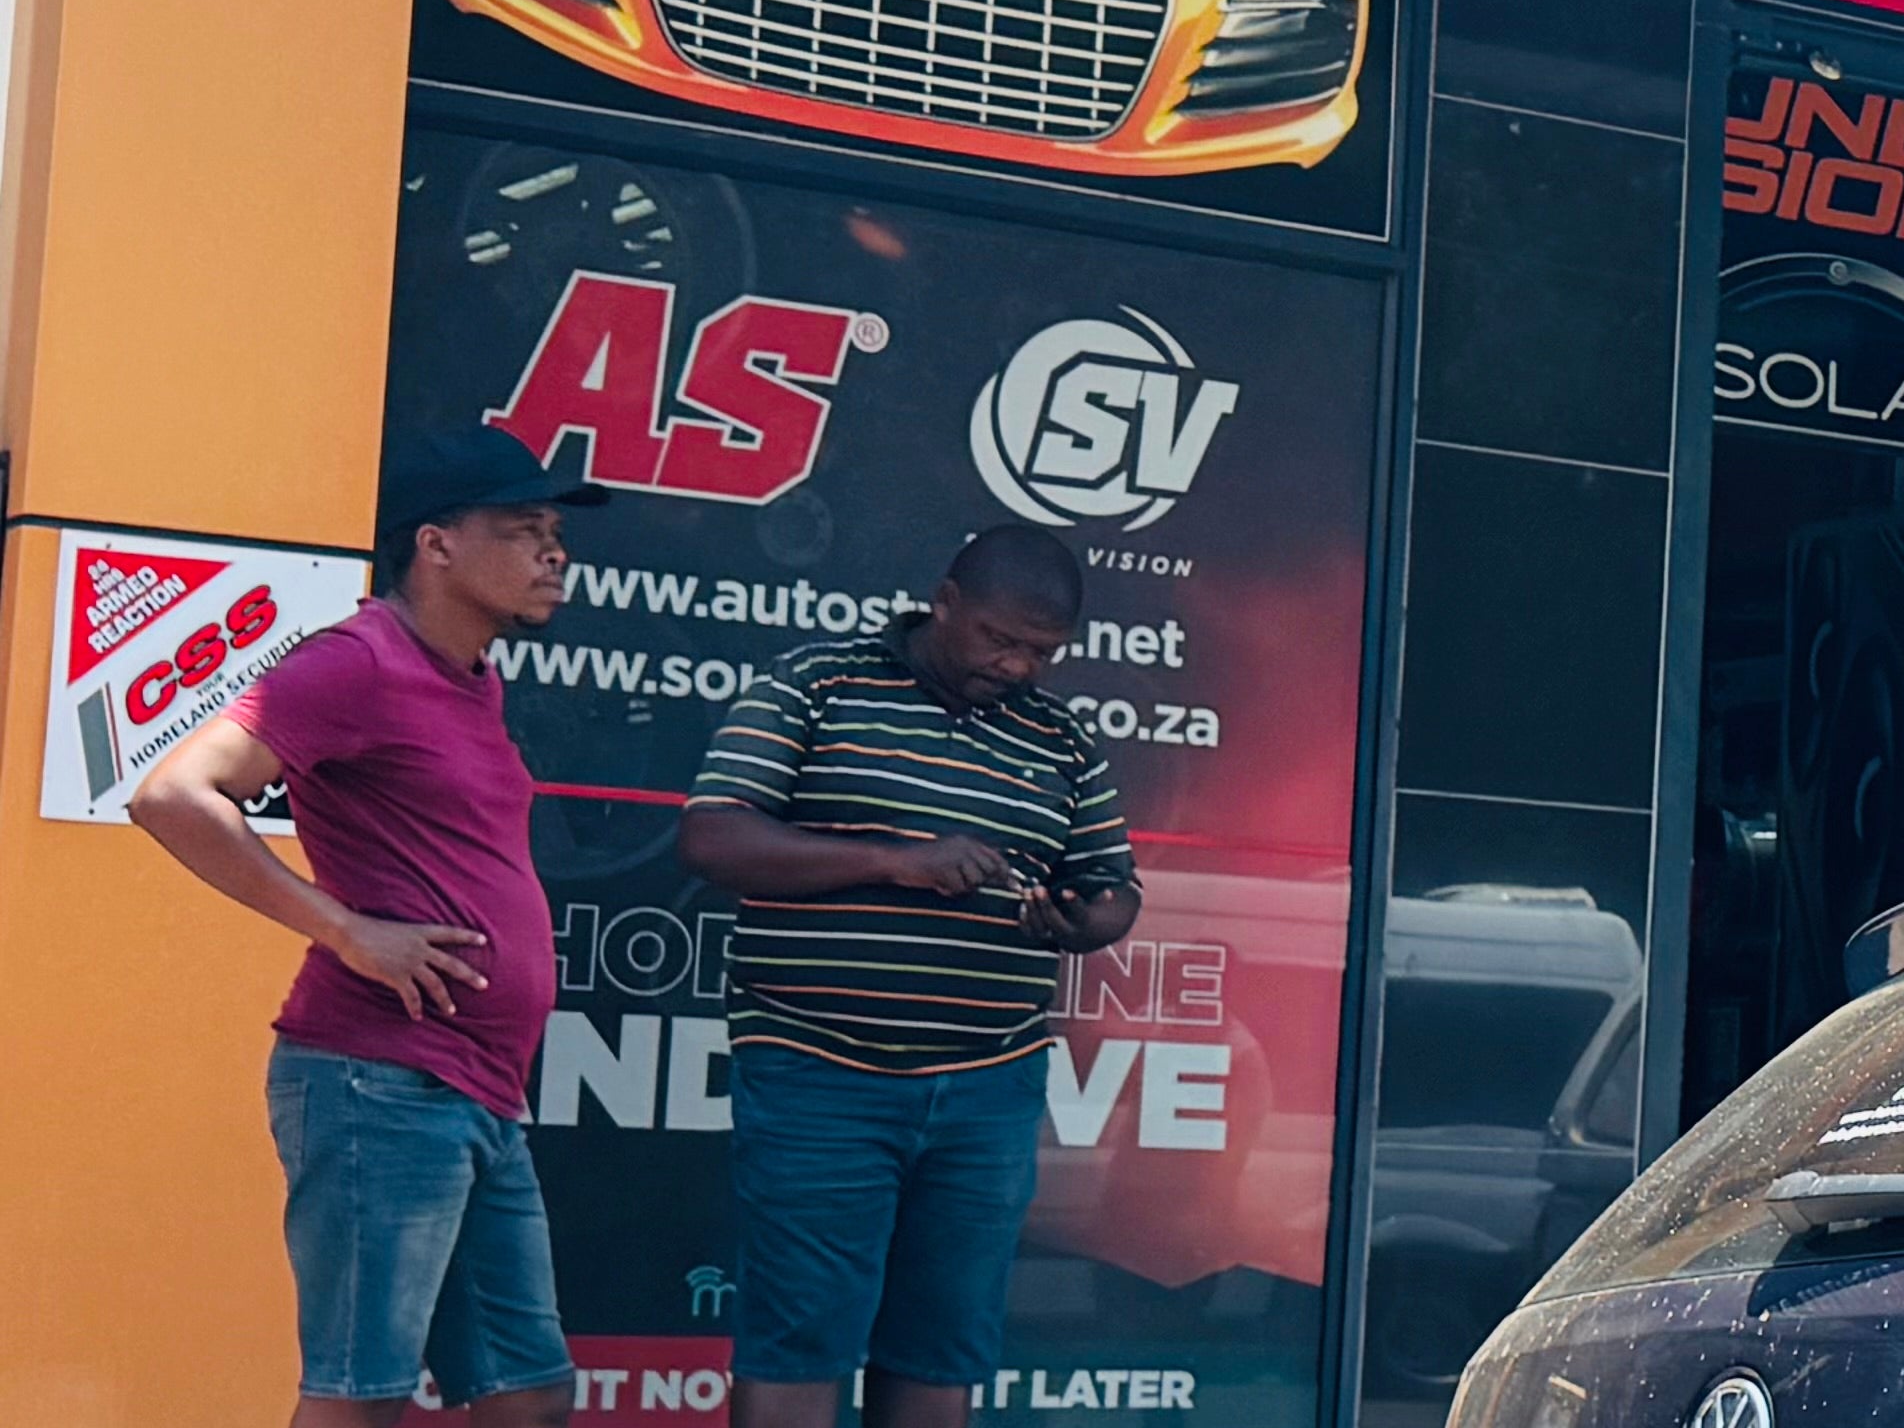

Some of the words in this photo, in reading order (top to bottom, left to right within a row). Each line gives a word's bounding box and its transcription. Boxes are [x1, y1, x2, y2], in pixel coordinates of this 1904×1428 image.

[484, 269, 858, 505] AS
[86, 566, 159, 626] ARMED
[1087, 547, 1193, 577] VISION
[88, 574, 188, 653] REACTION
[126, 584, 278, 726] CSS
[130, 690, 226, 768] HOMELAND
[574, 1369, 629, 1410] IT
[640, 1369, 733, 1411] NO
[1030, 1369, 1196, 1409] LATER
